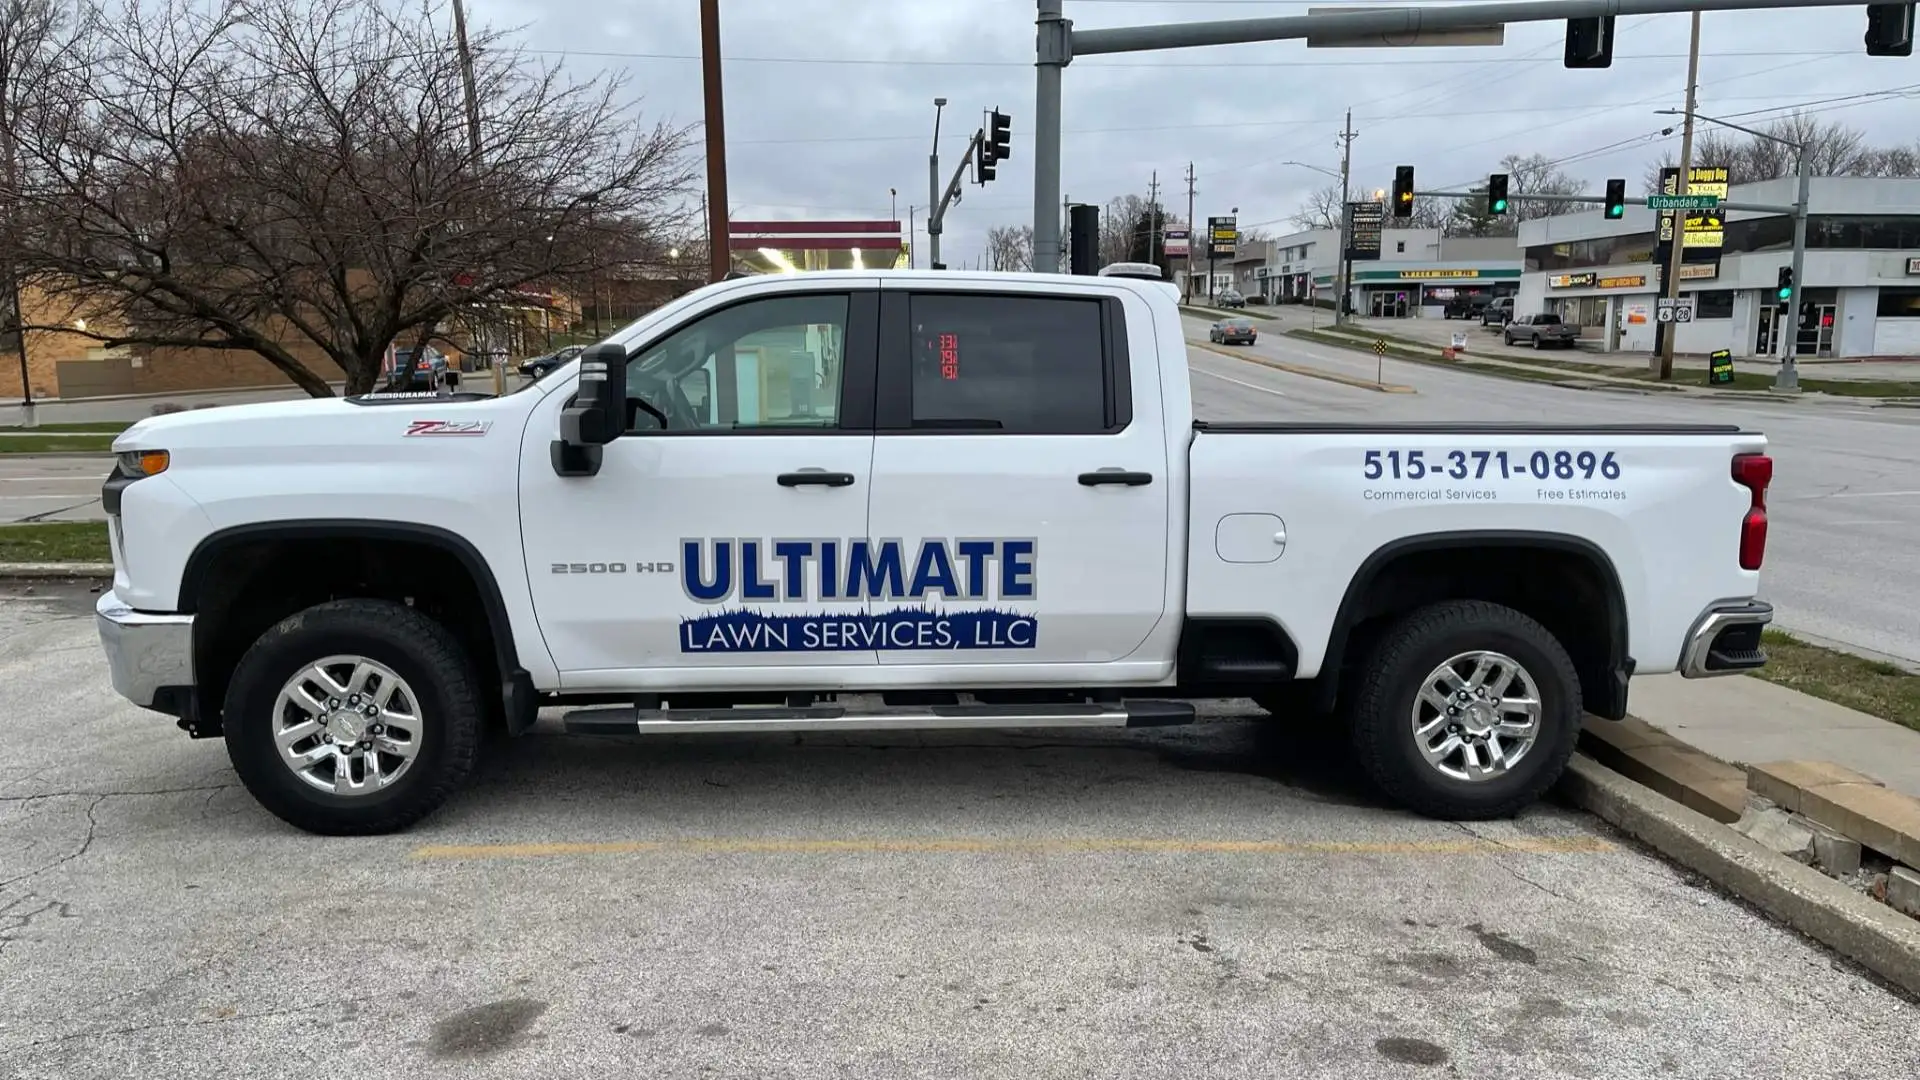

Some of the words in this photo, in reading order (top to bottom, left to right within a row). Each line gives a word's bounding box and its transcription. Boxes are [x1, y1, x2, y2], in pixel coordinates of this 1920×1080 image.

[1715, 167, 1728, 182] Dog
[1652, 197, 1699, 208] Urbandale
[1662, 310, 1669, 320] 6
[1678, 310, 1689, 320] 28
[393, 391, 439, 399] DURAMAX
[1364, 450, 1620, 480] 515-371-0896
[1363, 489, 1441, 501] Commercial
[1446, 489, 1497, 501] Services
[1537, 489, 1564, 501] Free
[1568, 489, 1627, 501] Estimates
[551, 562, 627, 574] 2500
[636, 561, 675, 573] HD
[680, 537, 1038, 604] ULTIMATE
[687, 623, 789, 648] LAWN
[802, 620, 960, 650] SERVICES,
[975, 620, 1031, 646] LLC
